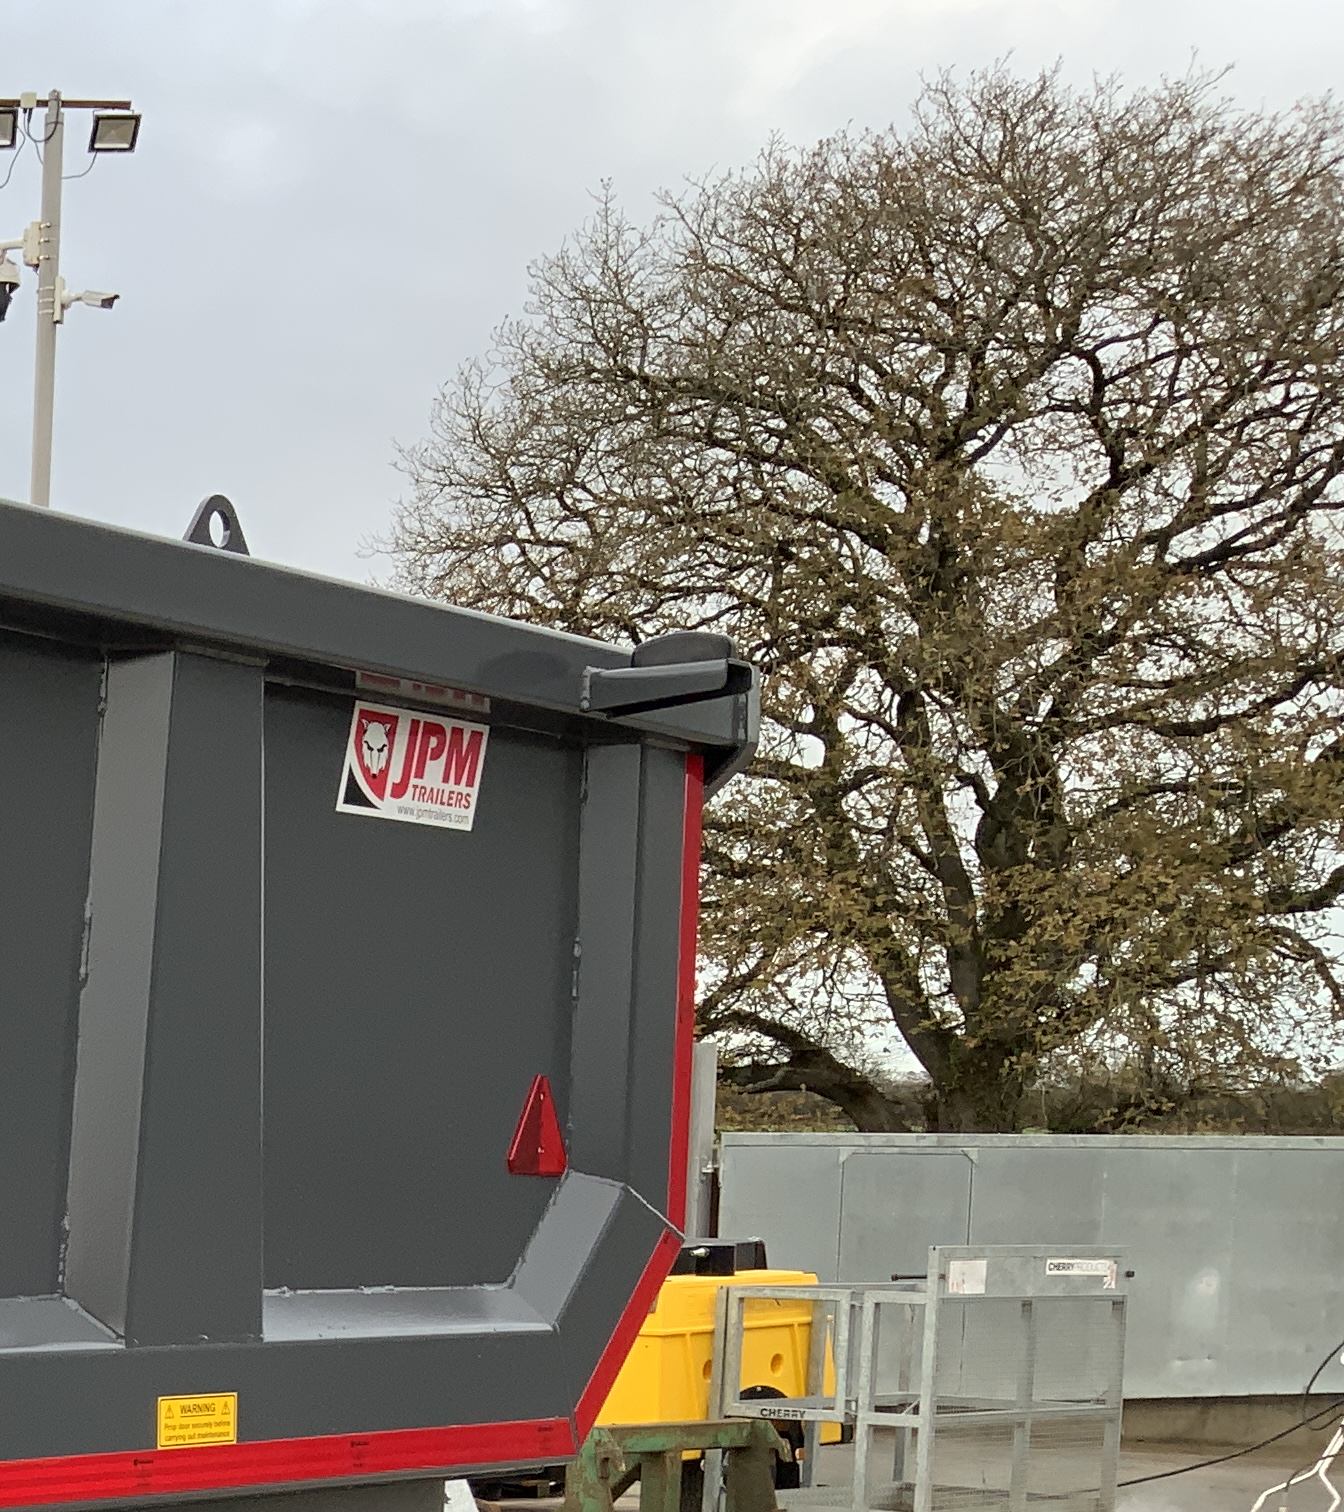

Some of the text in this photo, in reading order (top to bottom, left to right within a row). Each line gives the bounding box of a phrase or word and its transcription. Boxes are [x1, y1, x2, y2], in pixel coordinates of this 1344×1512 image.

[390, 718, 484, 800] JPM
[412, 784, 472, 810] TRAILERS
[179, 1402, 216, 1415] WARNING
[760, 1408, 806, 1419] CHERRY
